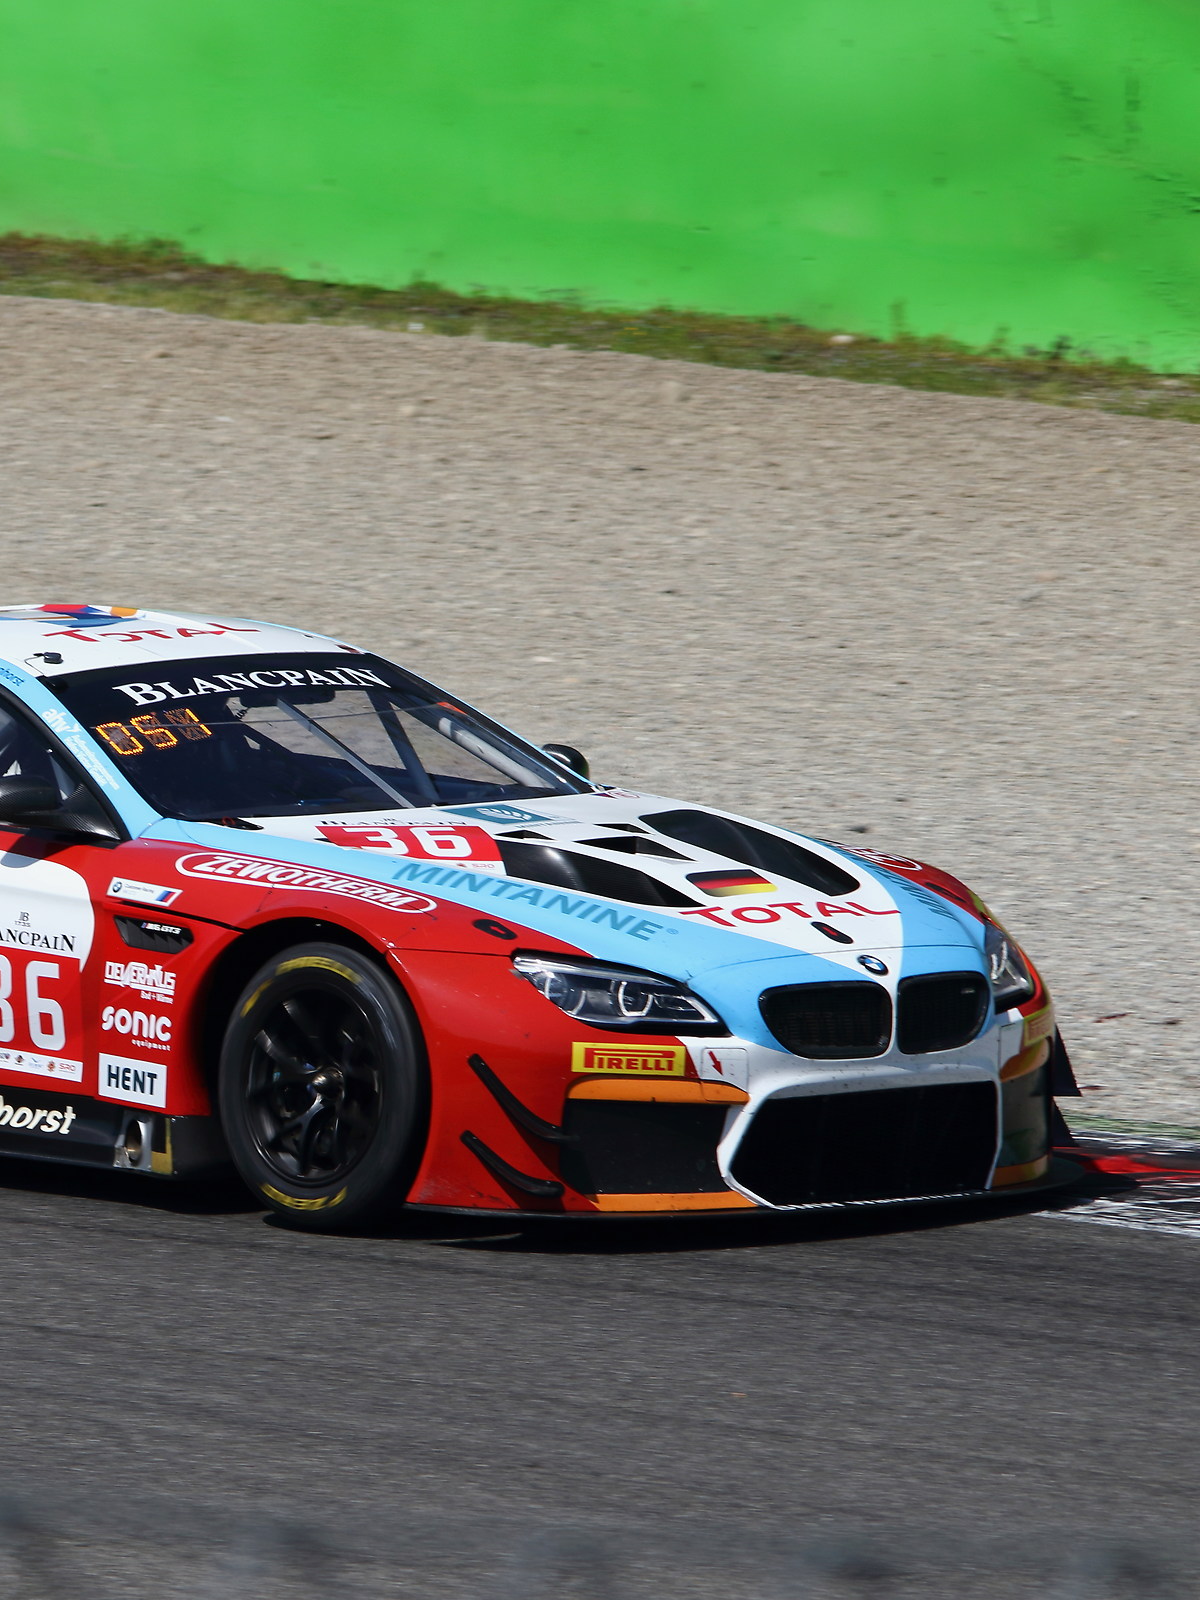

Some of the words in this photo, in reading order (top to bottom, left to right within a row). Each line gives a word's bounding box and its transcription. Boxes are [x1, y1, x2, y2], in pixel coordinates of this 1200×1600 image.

[43, 622, 261, 644] TOTAL
[113, 666, 391, 706] BLANCPAIN
[342, 827, 473, 858] 36
[192, 855, 412, 908] ZEWOTHERM
[679, 900, 902, 927] TOTAL
[584, 1047, 676, 1071] PIRELLI
[107, 1064, 157, 1095] HENT
